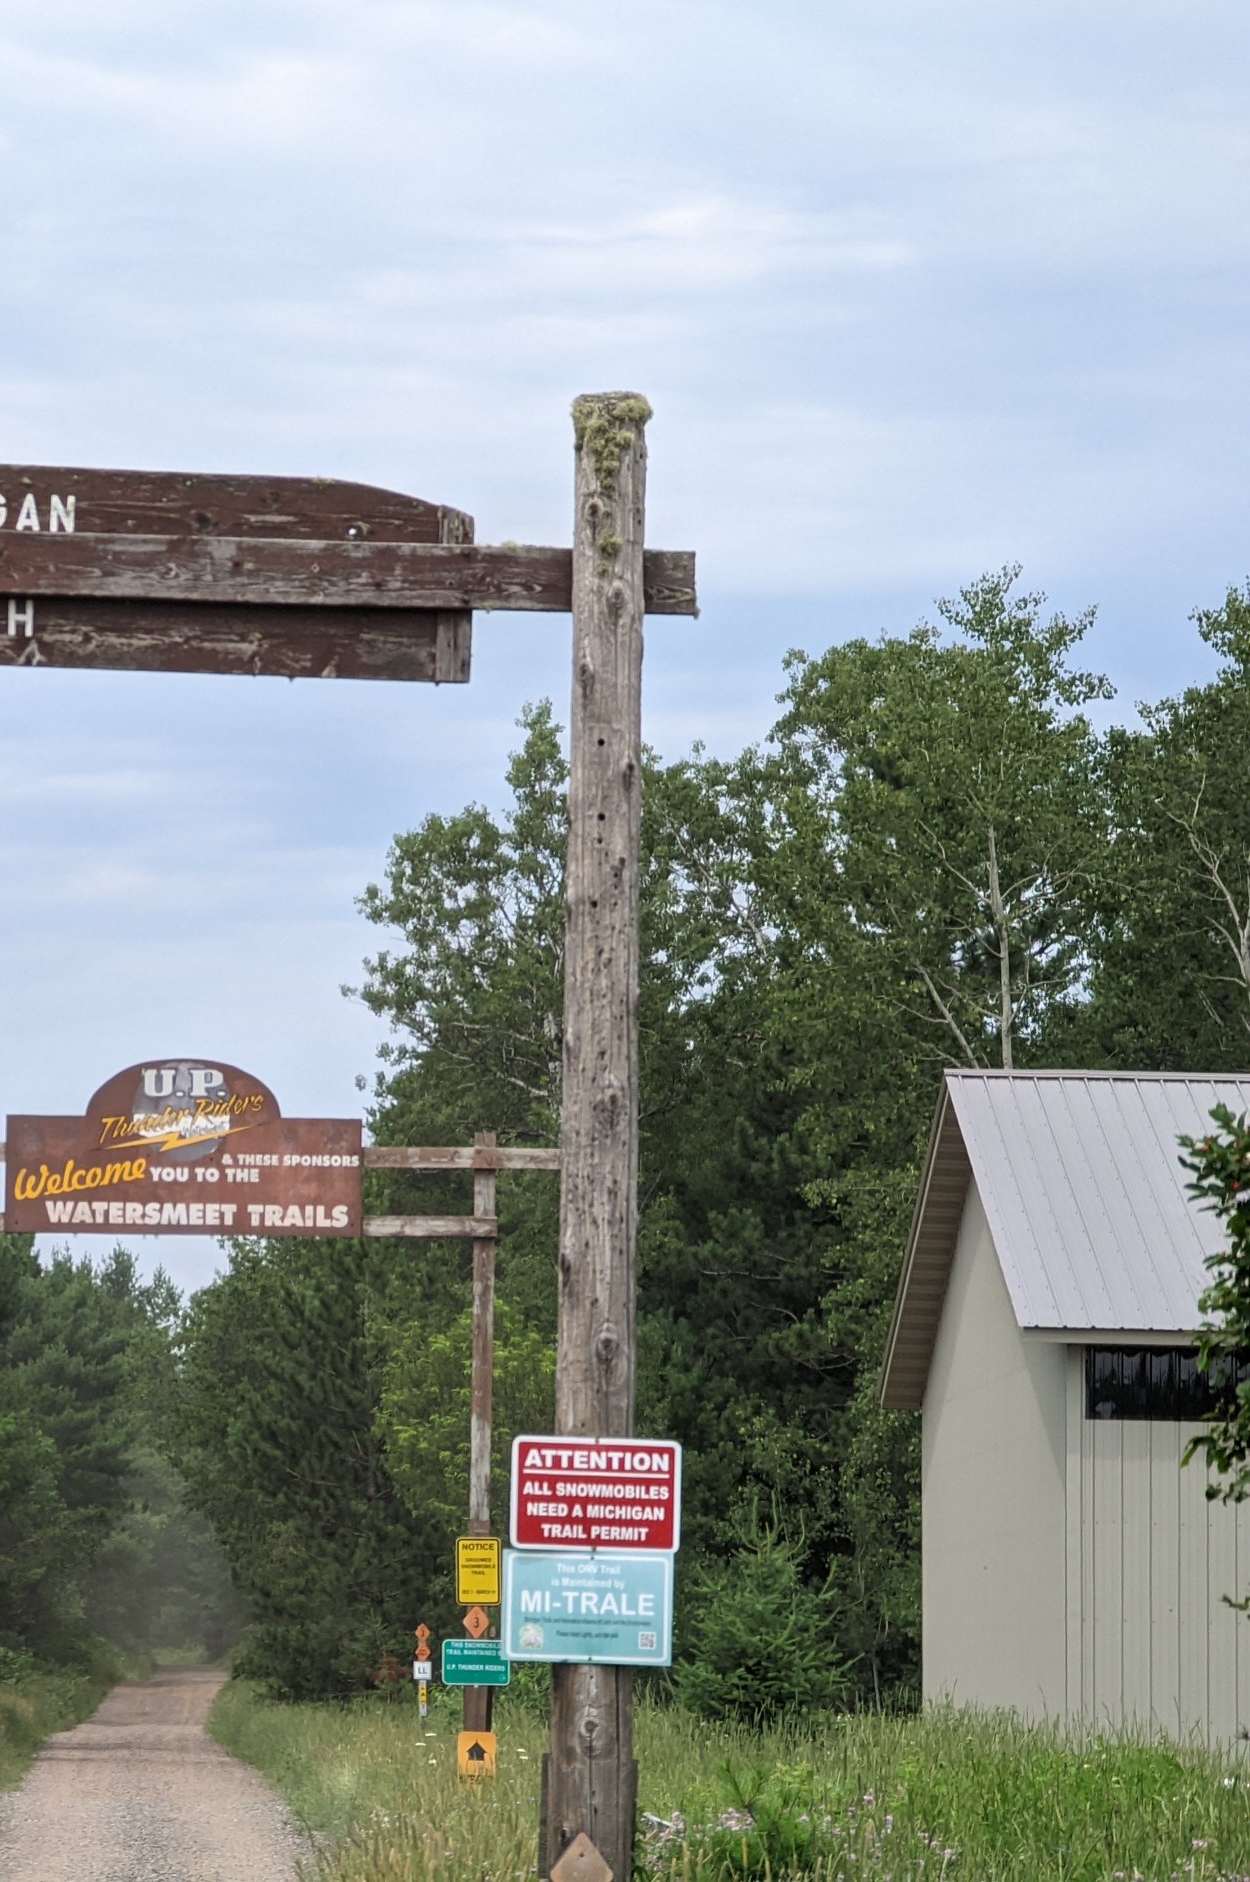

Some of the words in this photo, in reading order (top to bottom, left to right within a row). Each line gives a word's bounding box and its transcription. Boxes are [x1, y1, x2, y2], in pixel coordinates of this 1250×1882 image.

[142, 1067, 227, 1098] U.P.
[99, 1105, 191, 1144] Thunder
[191, 1093, 264, 1127] Riders
[222, 1153, 233, 1166] &
[237, 1154, 279, 1167] THESE
[282, 1154, 360, 1168] SPONSORS
[14, 1158, 147, 1200] Welcome
[150, 1167, 190, 1183] YOU
[194, 1167, 220, 1183] TO
[225, 1167, 260, 1183] THE
[45, 1200, 237, 1226] WATERSMEET
[247, 1204, 349, 1228] TRAILS
[524, 1449, 670, 1471] ATTENTION
[523, 1481, 552, 1496] ALL
[556, 1483, 669, 1500] SNOWMOBILES
[527, 1503, 568, 1517] NEED
[571, 1503, 583, 1518] A
[586, 1504, 665, 1521] MICHIGAN
[541, 1524, 587, 1539] TRAIL
[591, 1525, 649, 1541] PERMIT
[462, 1543, 495, 1551] NOTICE
[557, 1563, 576, 1573] This
[600, 1565, 620, 1575] Trail
[562, 1578, 612, 1588] Maintained
[614, 1580, 626, 1590] by
[520, 1590, 655, 1616] MI-TRALE
[473, 1617, 480, 1628] 3
